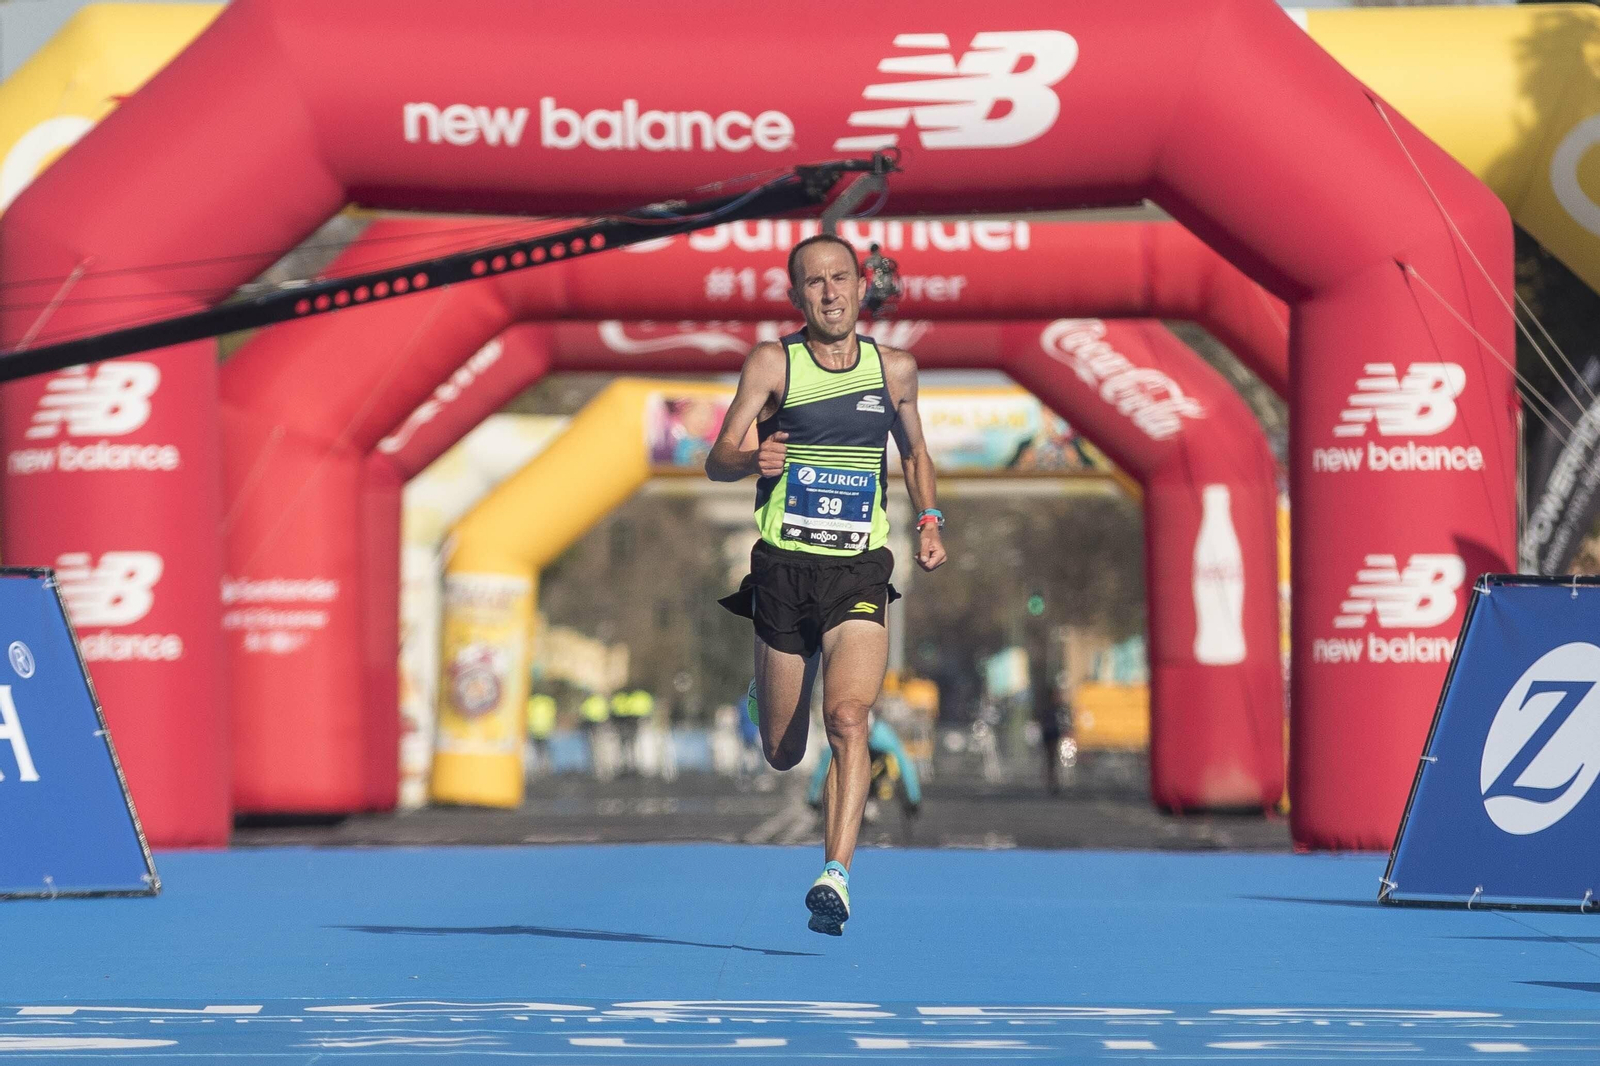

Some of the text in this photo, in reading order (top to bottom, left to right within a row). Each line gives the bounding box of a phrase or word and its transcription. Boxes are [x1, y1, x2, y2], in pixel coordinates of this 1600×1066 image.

[403, 97, 794, 152] new balance
[687, 219, 1031, 253] Sanander
[57, 439, 181, 472] balance
[1312, 440, 1484, 473] new balance
[817, 473, 868, 487] ZURICH
[817, 496, 842, 515] 39
[80, 630, 184, 661] alance
[1312, 631, 1457, 664] new balan
